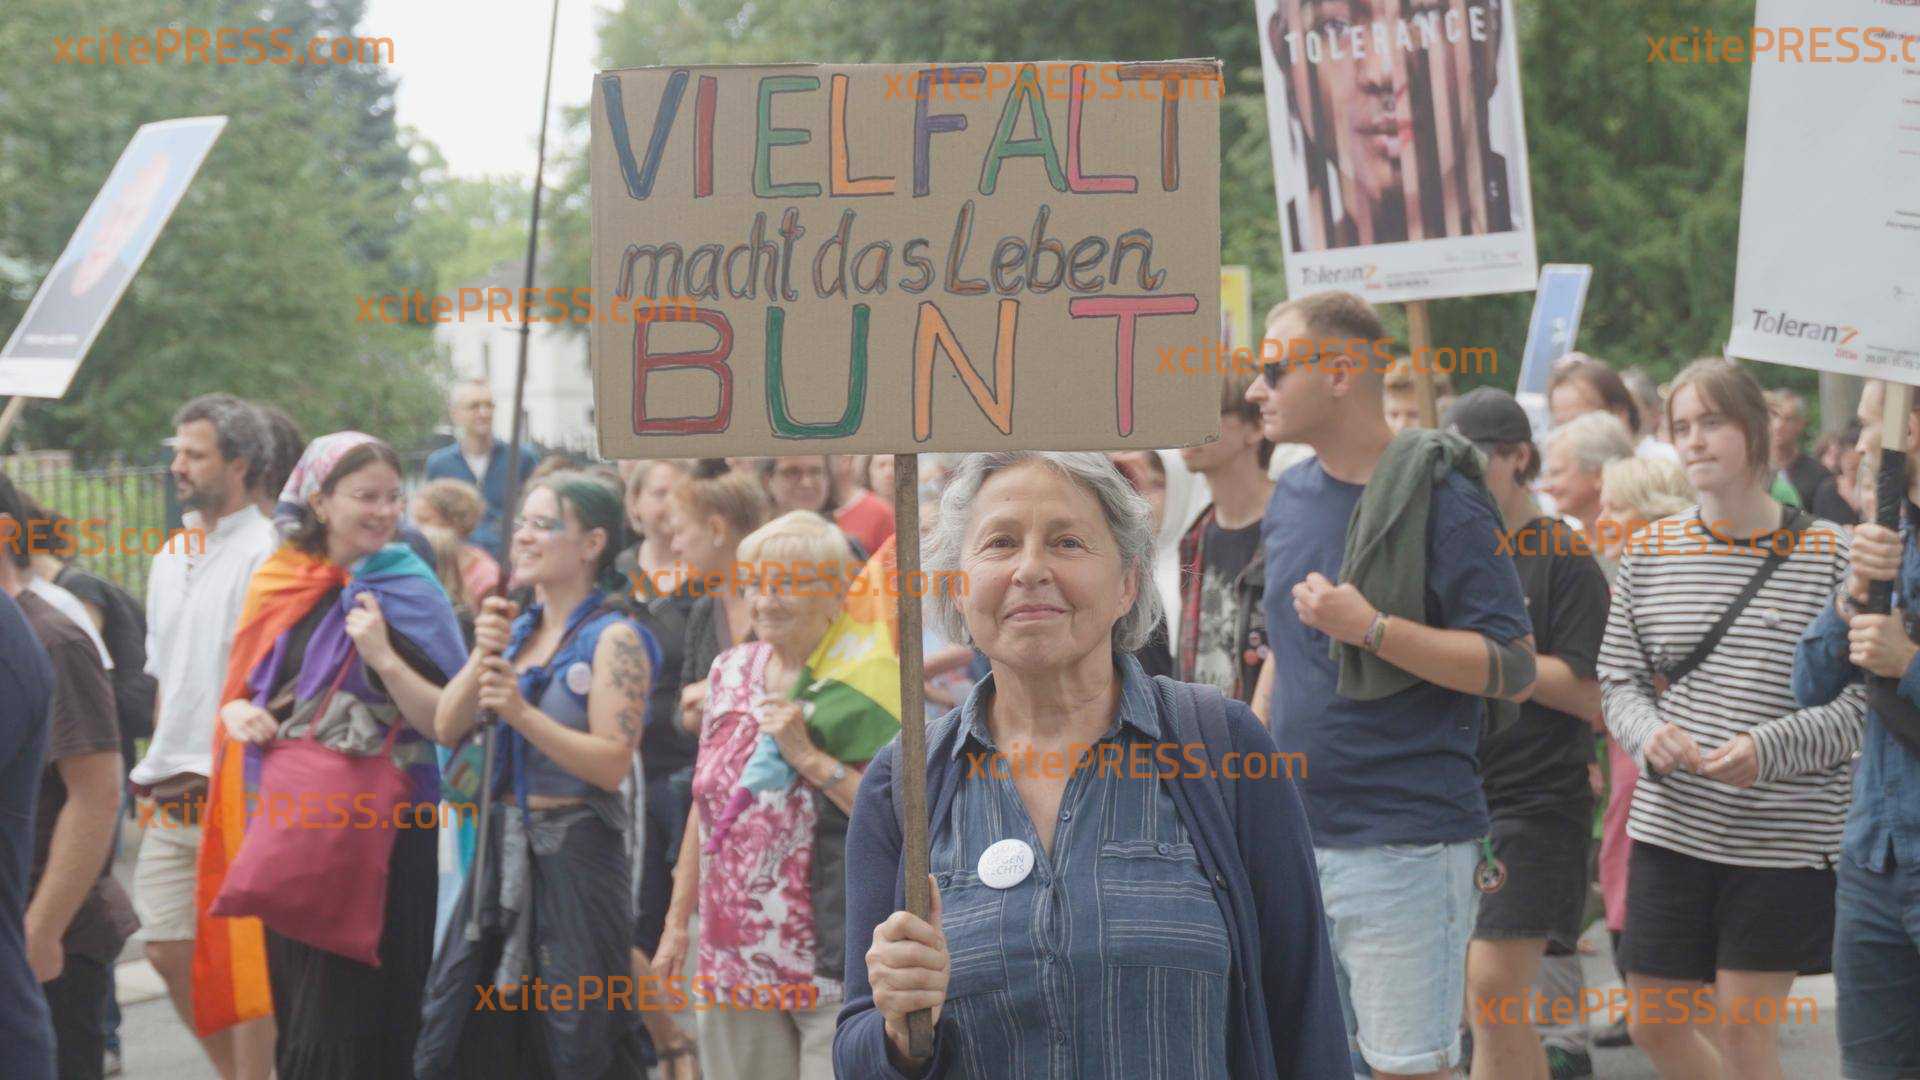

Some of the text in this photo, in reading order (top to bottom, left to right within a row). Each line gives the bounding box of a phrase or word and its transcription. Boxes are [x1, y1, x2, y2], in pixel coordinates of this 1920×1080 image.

[1284, 6, 1488, 66] TOLERANCE
[603, 63, 1224, 199] VIELFALT
[616, 199, 1168, 301] macht das Leben
[632, 294, 1199, 442] BUNT
